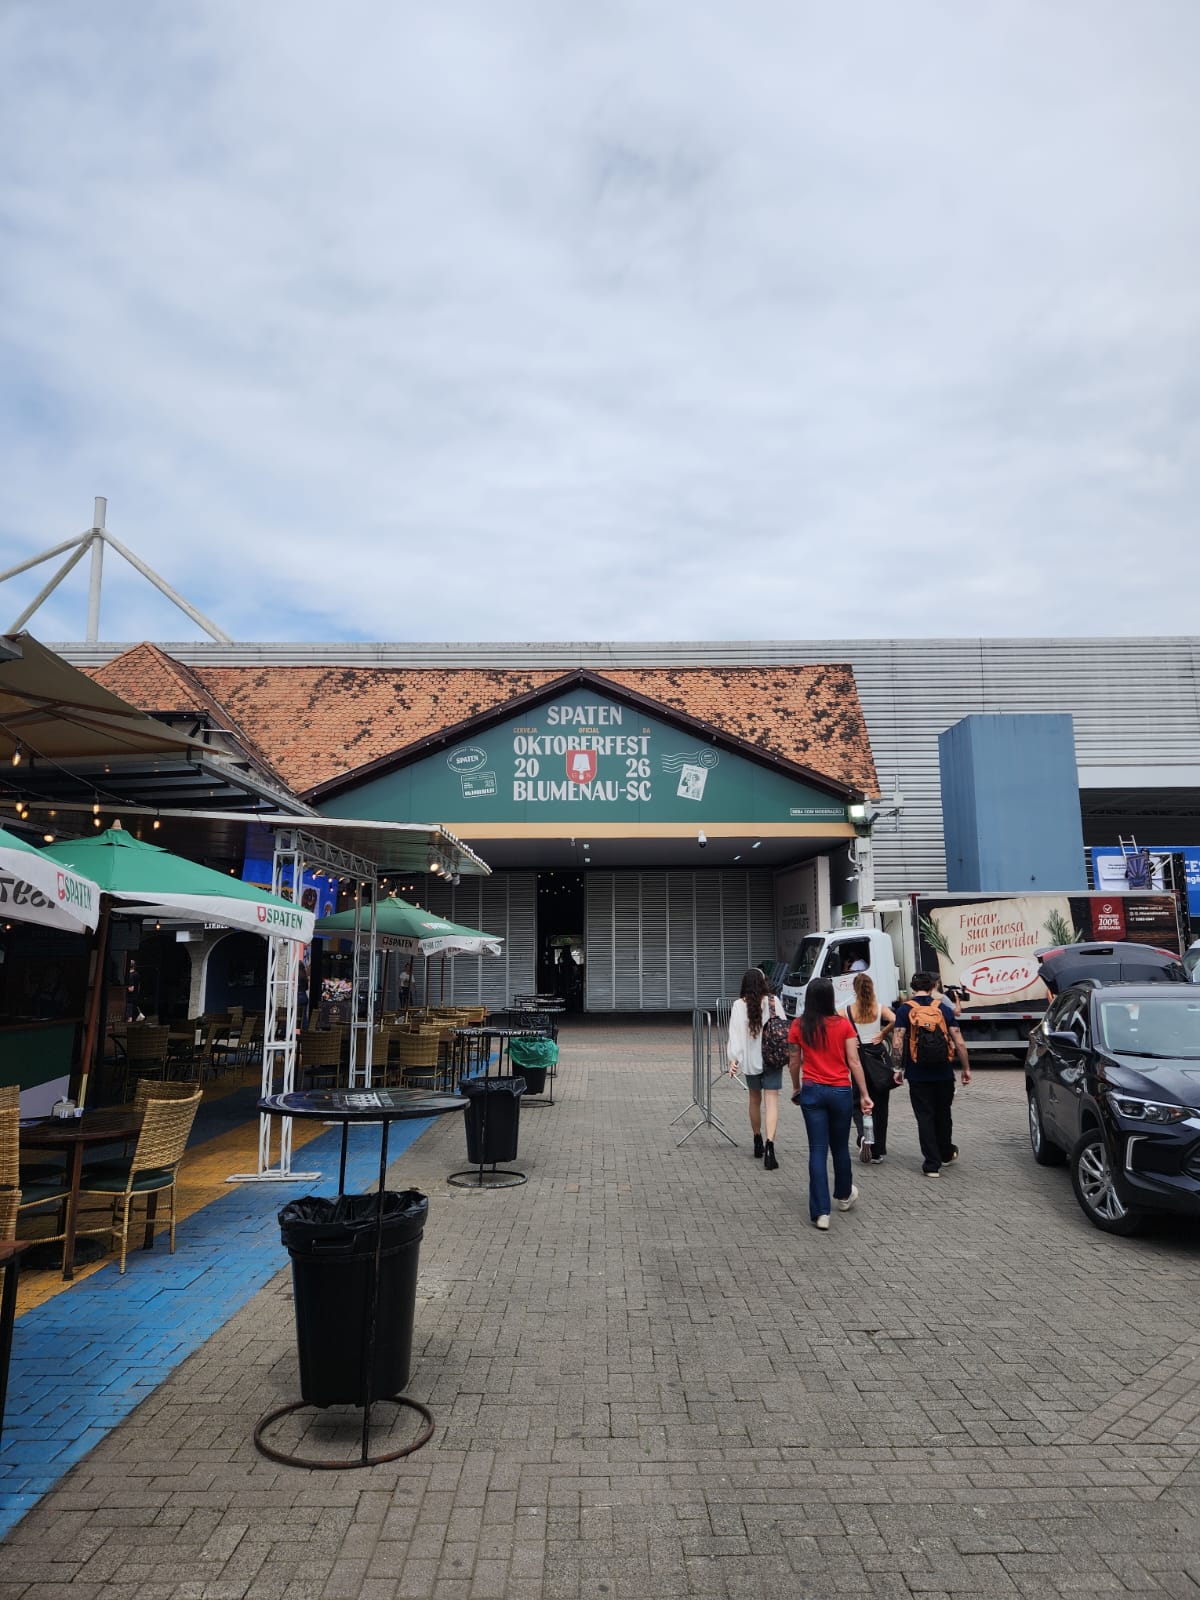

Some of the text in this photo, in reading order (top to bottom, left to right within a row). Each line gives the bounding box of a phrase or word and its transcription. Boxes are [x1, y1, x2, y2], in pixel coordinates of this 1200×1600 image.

[547, 705, 622, 726] SPATEN
[513, 735, 652, 756] OKTOBERFEST
[514, 758, 540, 778] 20
[625, 758, 651, 778] 26
[513, 780, 652, 801] BLUMENAU-SC
[65, 876, 92, 911] SPATEN
[267, 907, 303, 930] SPATEN
[960, 912, 1000, 929] Fricar,
[1098, 918, 1120, 926] 100%
[967, 921, 1024, 941] sua mesa
[388, 938, 413, 949] SPATEN
[960, 930, 1039, 956] bem servida!
[971, 966, 1030, 987] Fricar
